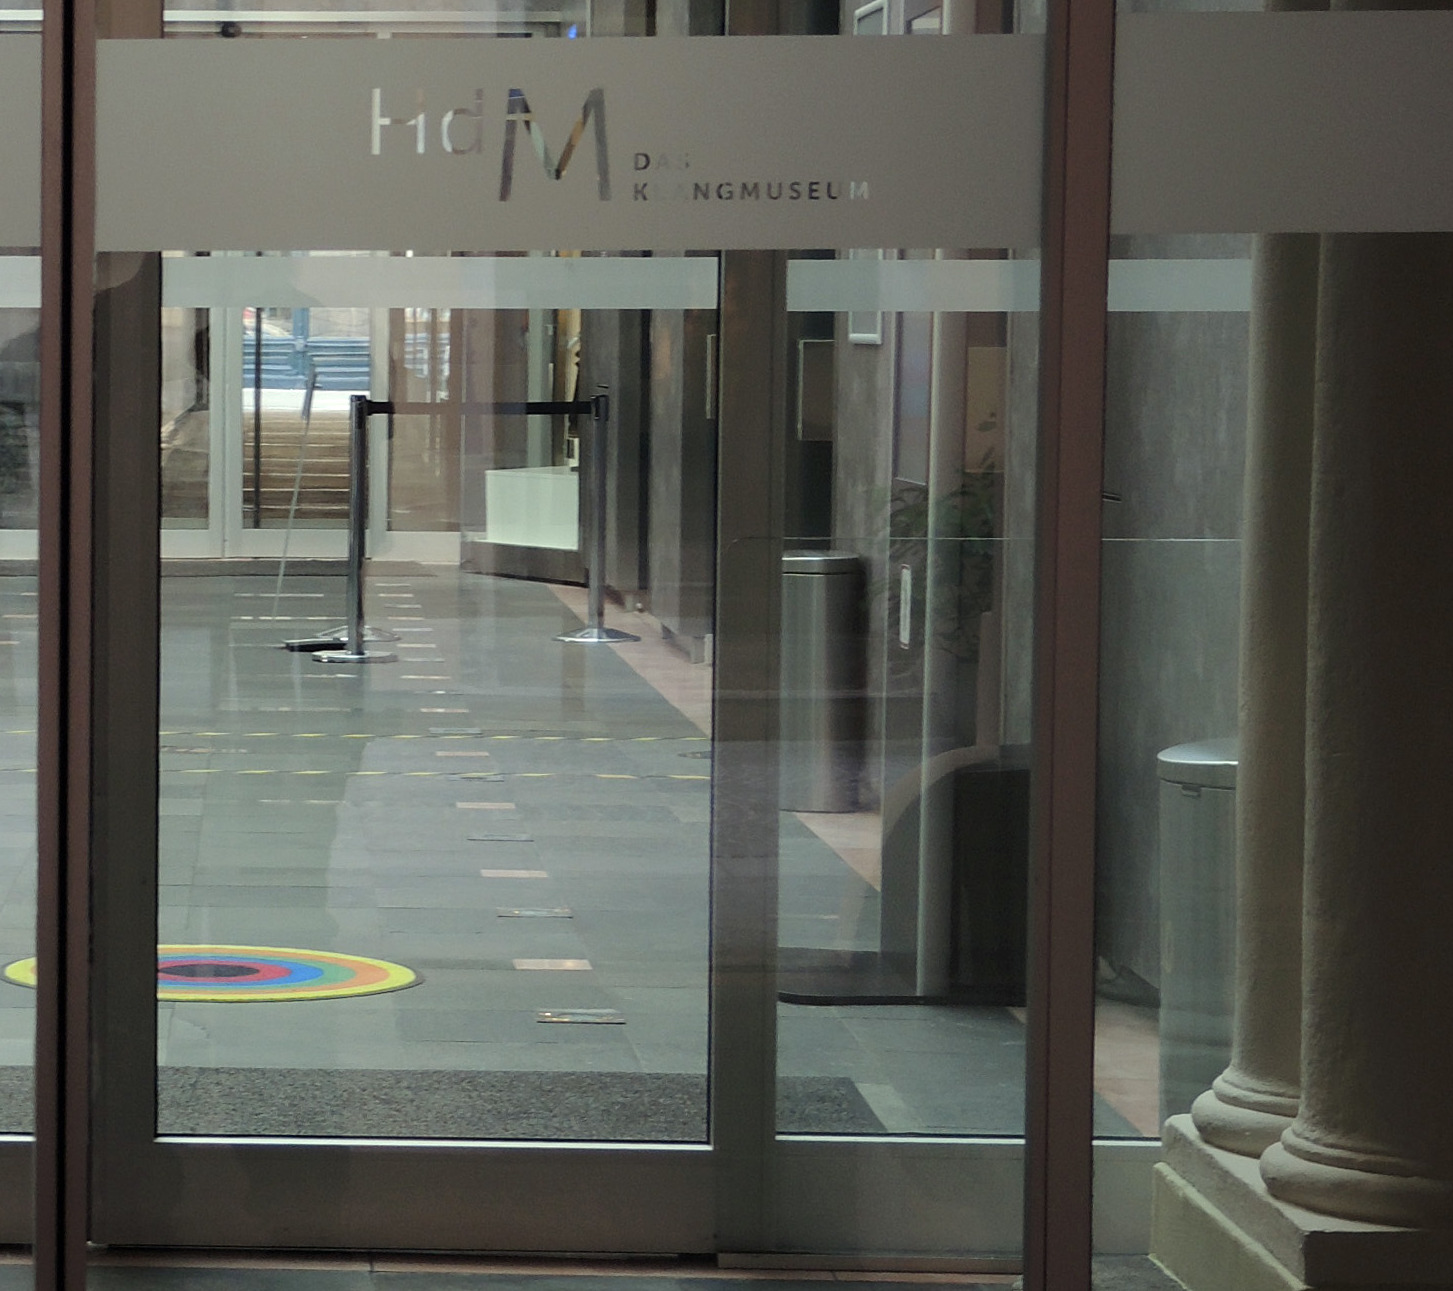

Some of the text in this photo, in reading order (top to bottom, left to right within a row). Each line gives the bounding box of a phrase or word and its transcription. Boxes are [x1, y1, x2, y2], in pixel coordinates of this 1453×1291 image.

[371, 88, 612, 202] HdM
[633, 152, 690, 171] DA
[633, 181, 869, 202] KNGMUSEUM
